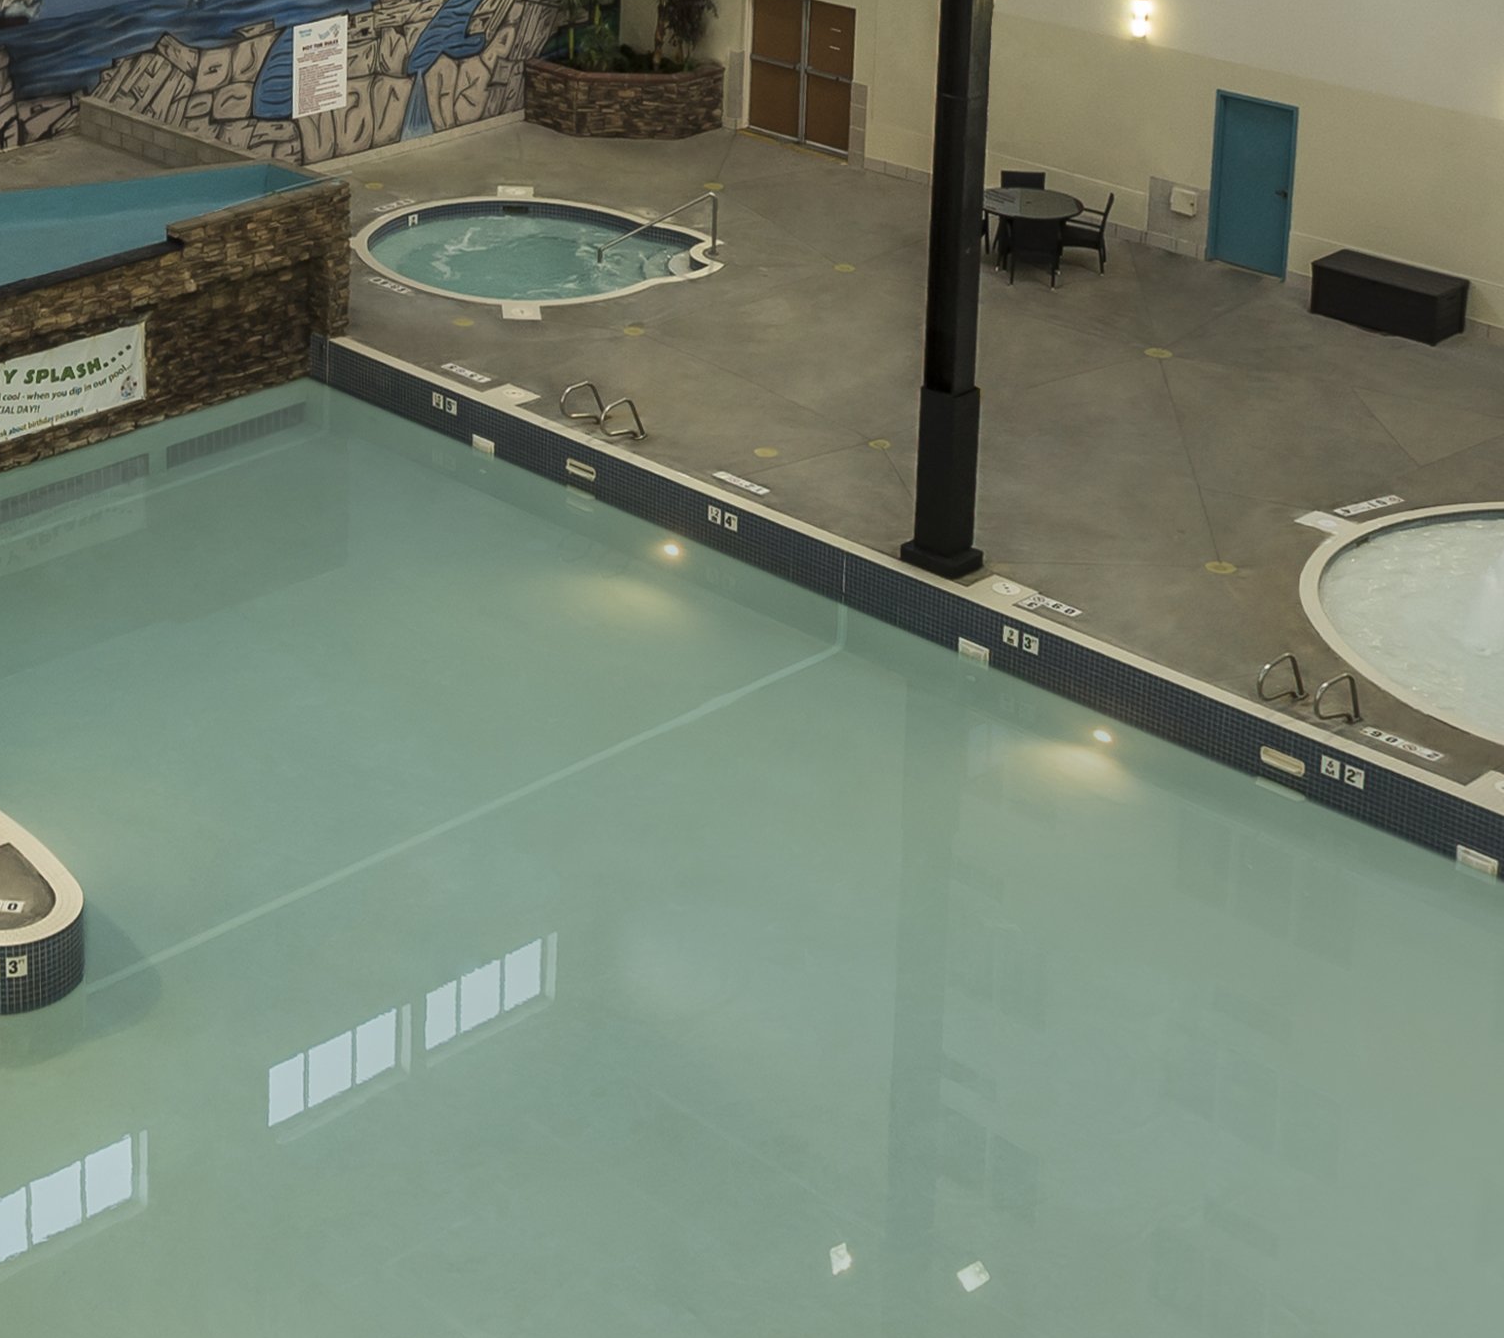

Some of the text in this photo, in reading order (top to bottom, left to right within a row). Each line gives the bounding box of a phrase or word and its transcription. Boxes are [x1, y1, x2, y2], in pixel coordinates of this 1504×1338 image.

[2, 392, 21, 401] cool
[27, 390, 50, 400] when
[51, 390, 67, 401] you
[69, 385, 82, 396] dip
[83, 382, 92, 392] in
[93, 377, 107, 388] our
[8, 424, 27, 435] about
[28, 416, 54, 429] birthday
